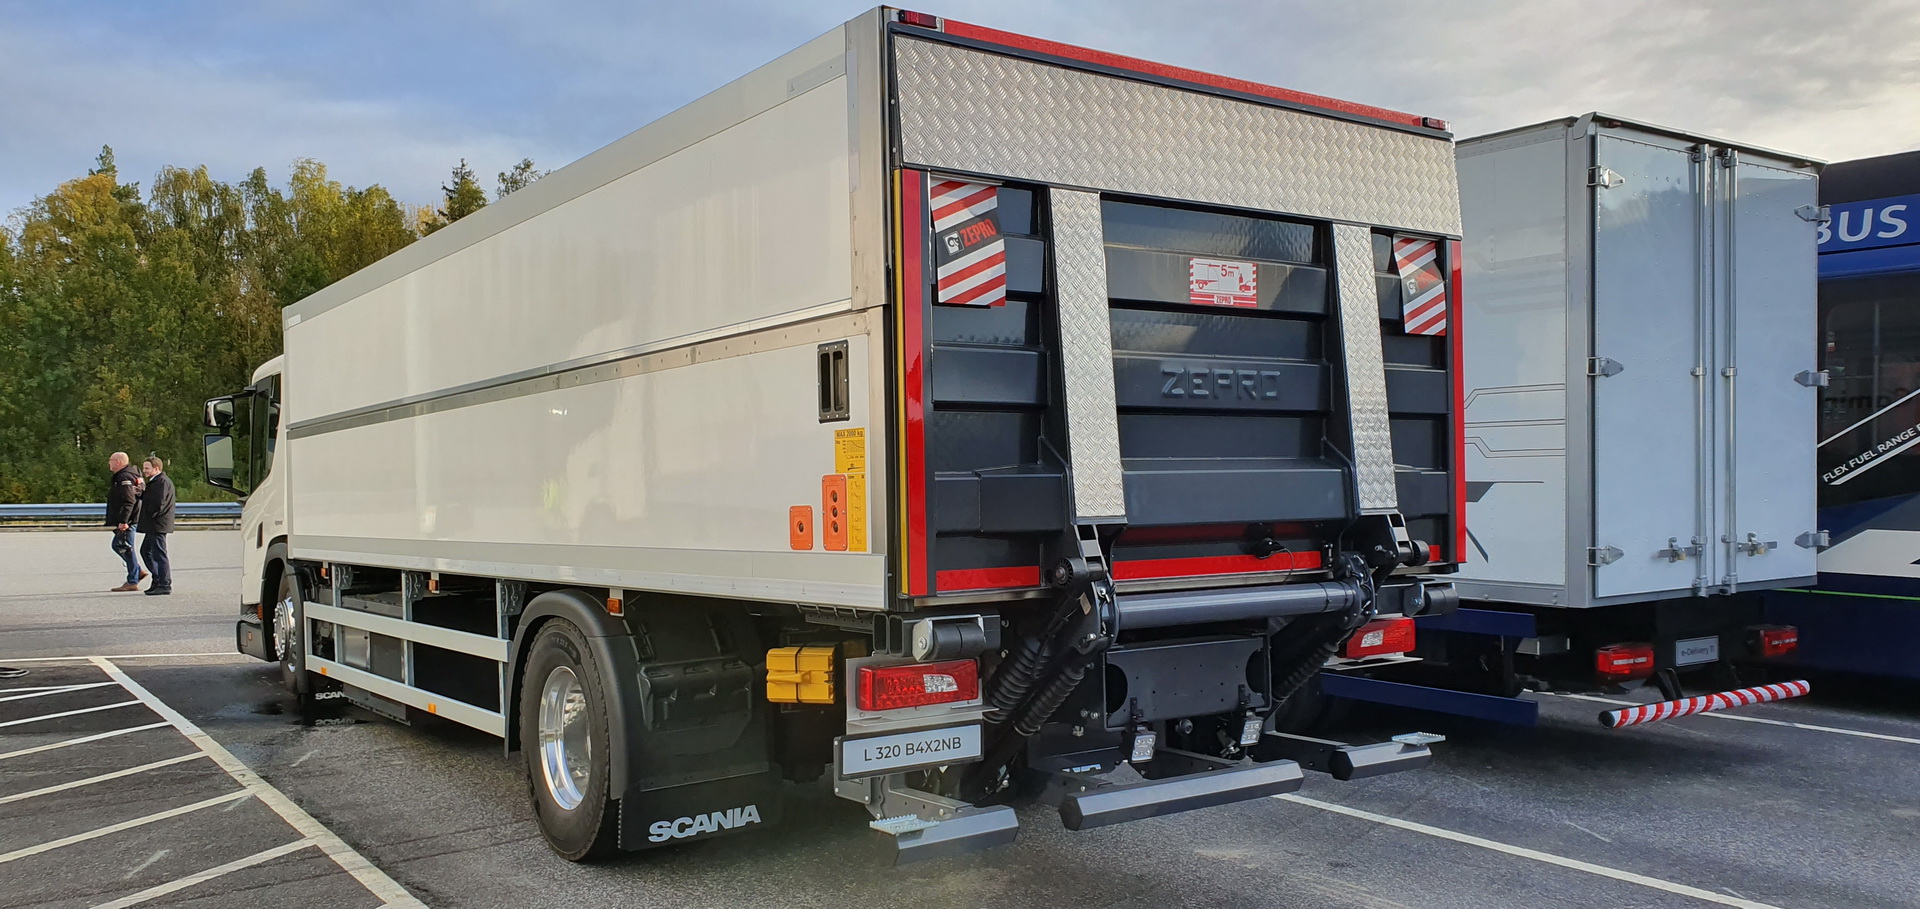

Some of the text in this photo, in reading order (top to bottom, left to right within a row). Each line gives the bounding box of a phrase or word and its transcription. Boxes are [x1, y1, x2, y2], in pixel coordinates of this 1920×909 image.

[959, 219, 997, 247] ZEPRO
[1216, 295, 1231, 304] ZEPRO
[1161, 367, 1280, 399] ZEPRO
[1823, 463, 1849, 482] FLEX
[1849, 449, 1878, 468] FUEL
[1877, 427, 1917, 453] RANGE
[315, 691, 346, 700] SCAN
[864, 736, 962, 762] L 320 B4X2NB
[648, 804, 762, 843] SCANIA
